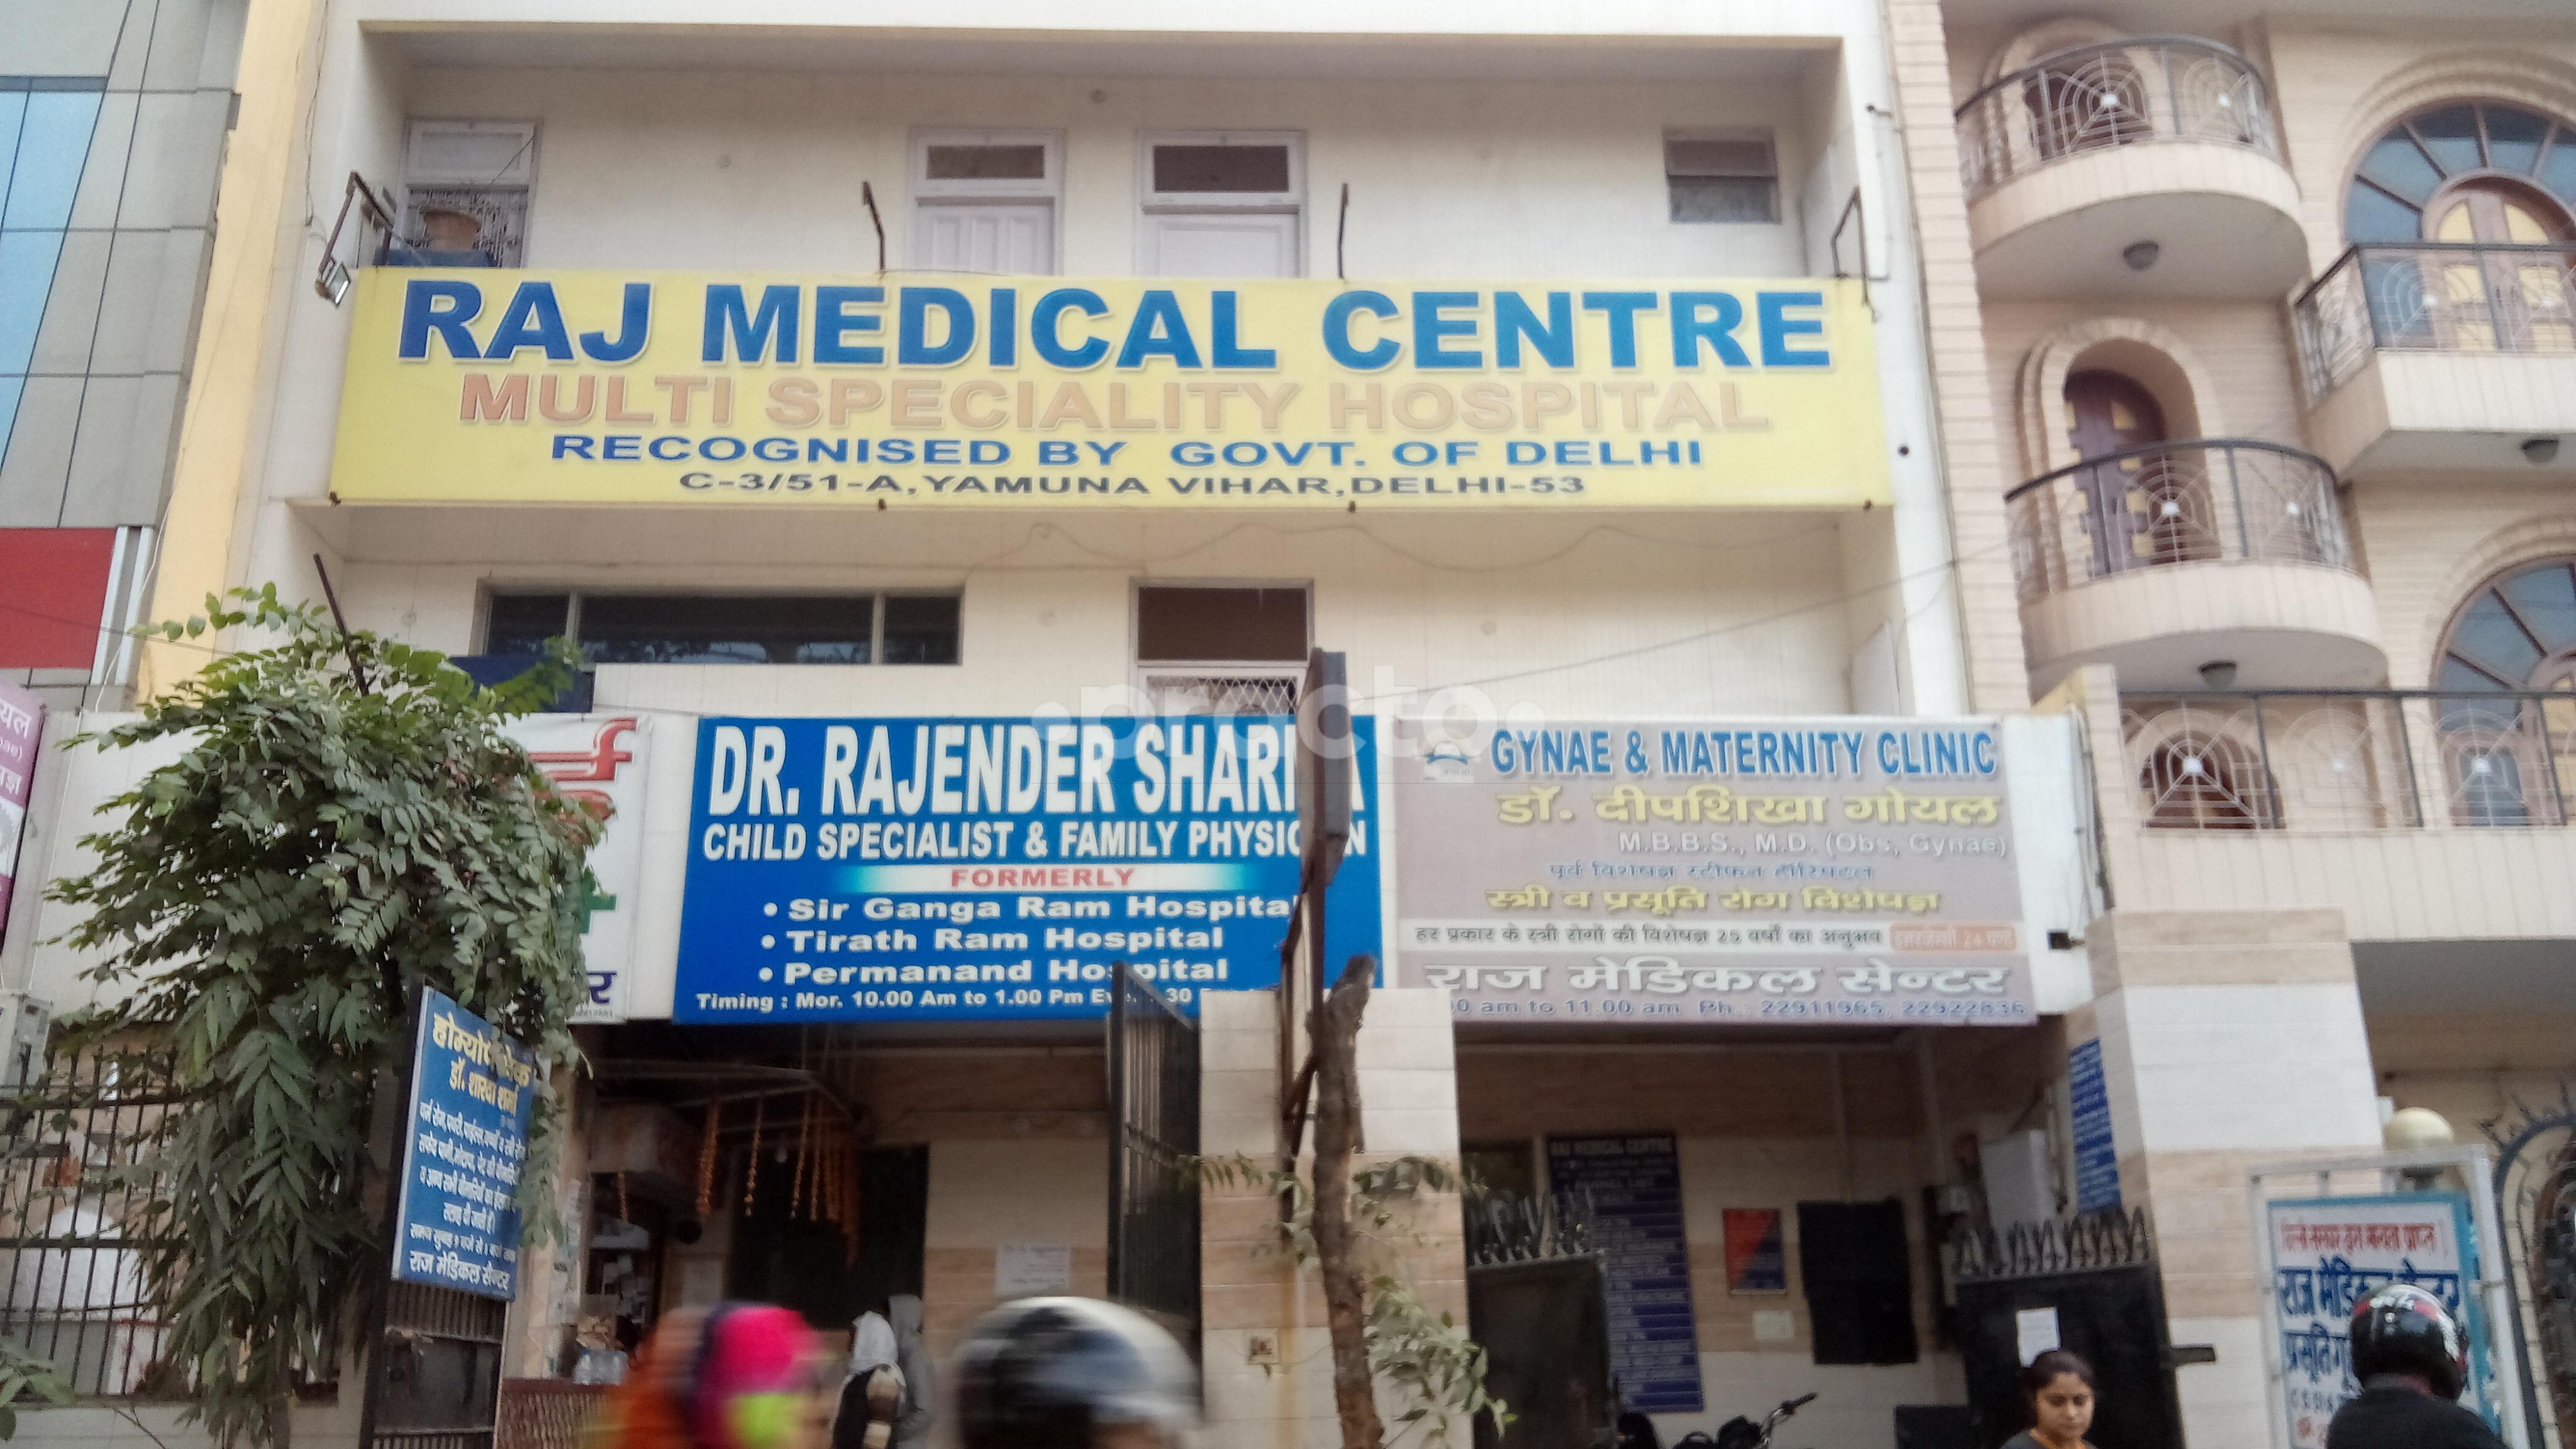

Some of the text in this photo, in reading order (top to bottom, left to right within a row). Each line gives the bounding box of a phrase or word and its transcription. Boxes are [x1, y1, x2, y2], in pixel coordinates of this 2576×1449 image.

[398, 280, 1831, 371] RAJ MEDICAL CENTRE
[460, 374, 1770, 431] MULTI SPECIALITY HOSPITAL
[552, 434, 1702, 468] RECOGNISED BY GOVT. OF DELHI
[1490, 728, 1996, 775] GYNAE & MATERNITY CLINIC
[709, 723, 1367, 816] DR. RAJENDER SHAR
[1495, 783, 2002, 824] डॉ. दीपशिखा गोयल
[703, 822, 807, 860] CHILD
[816, 821, 1014, 860] SPECIALIST
[1024, 821, 1049, 858] &
[1060, 820, 1179, 858] FAMILY
[950, 867, 1136, 888] FORMERLY
[787, 897, 850, 922] Sir
[863, 897, 1001, 924] Ganga
[1017, 896, 1111, 919] Ram
[1484, 883, 1941, 917] स्त्री व प्रसूति रोग विशेषज्ञ
[785, 926, 1224, 954] Tirath Ram Hospital
[1415, 925, 1441, 942] हर
[1446, 925, 1496, 943] प्रकार
[1502, 923, 1520, 942] के
[1611, 922, 1637, 943] की
[1716, 928, 1742, 944] 25
[784, 958, 1228, 985] Permanand Hopital
[1424, 955, 2011, 995] राज मेडिकल सेन्टर
[696, 992, 774, 1013] Timing
[795, 991, 843, 1009] Mor.
[852, 989, 914, 1008] 10.00
[918, 990, 957, 1007] Am
[964, 991, 986, 1006] to
[995, 989, 1042, 1006] 1.00
[1048, 989, 1084, 1005] Pm
[1480, 1000, 1519, 1014] am
[1528, 999, 1554, 1014] to
[1565, 998, 1633, 1014] 11.00
[1641, 999, 1681, 1014] am
[409, 1250, 435, 1274] राज
